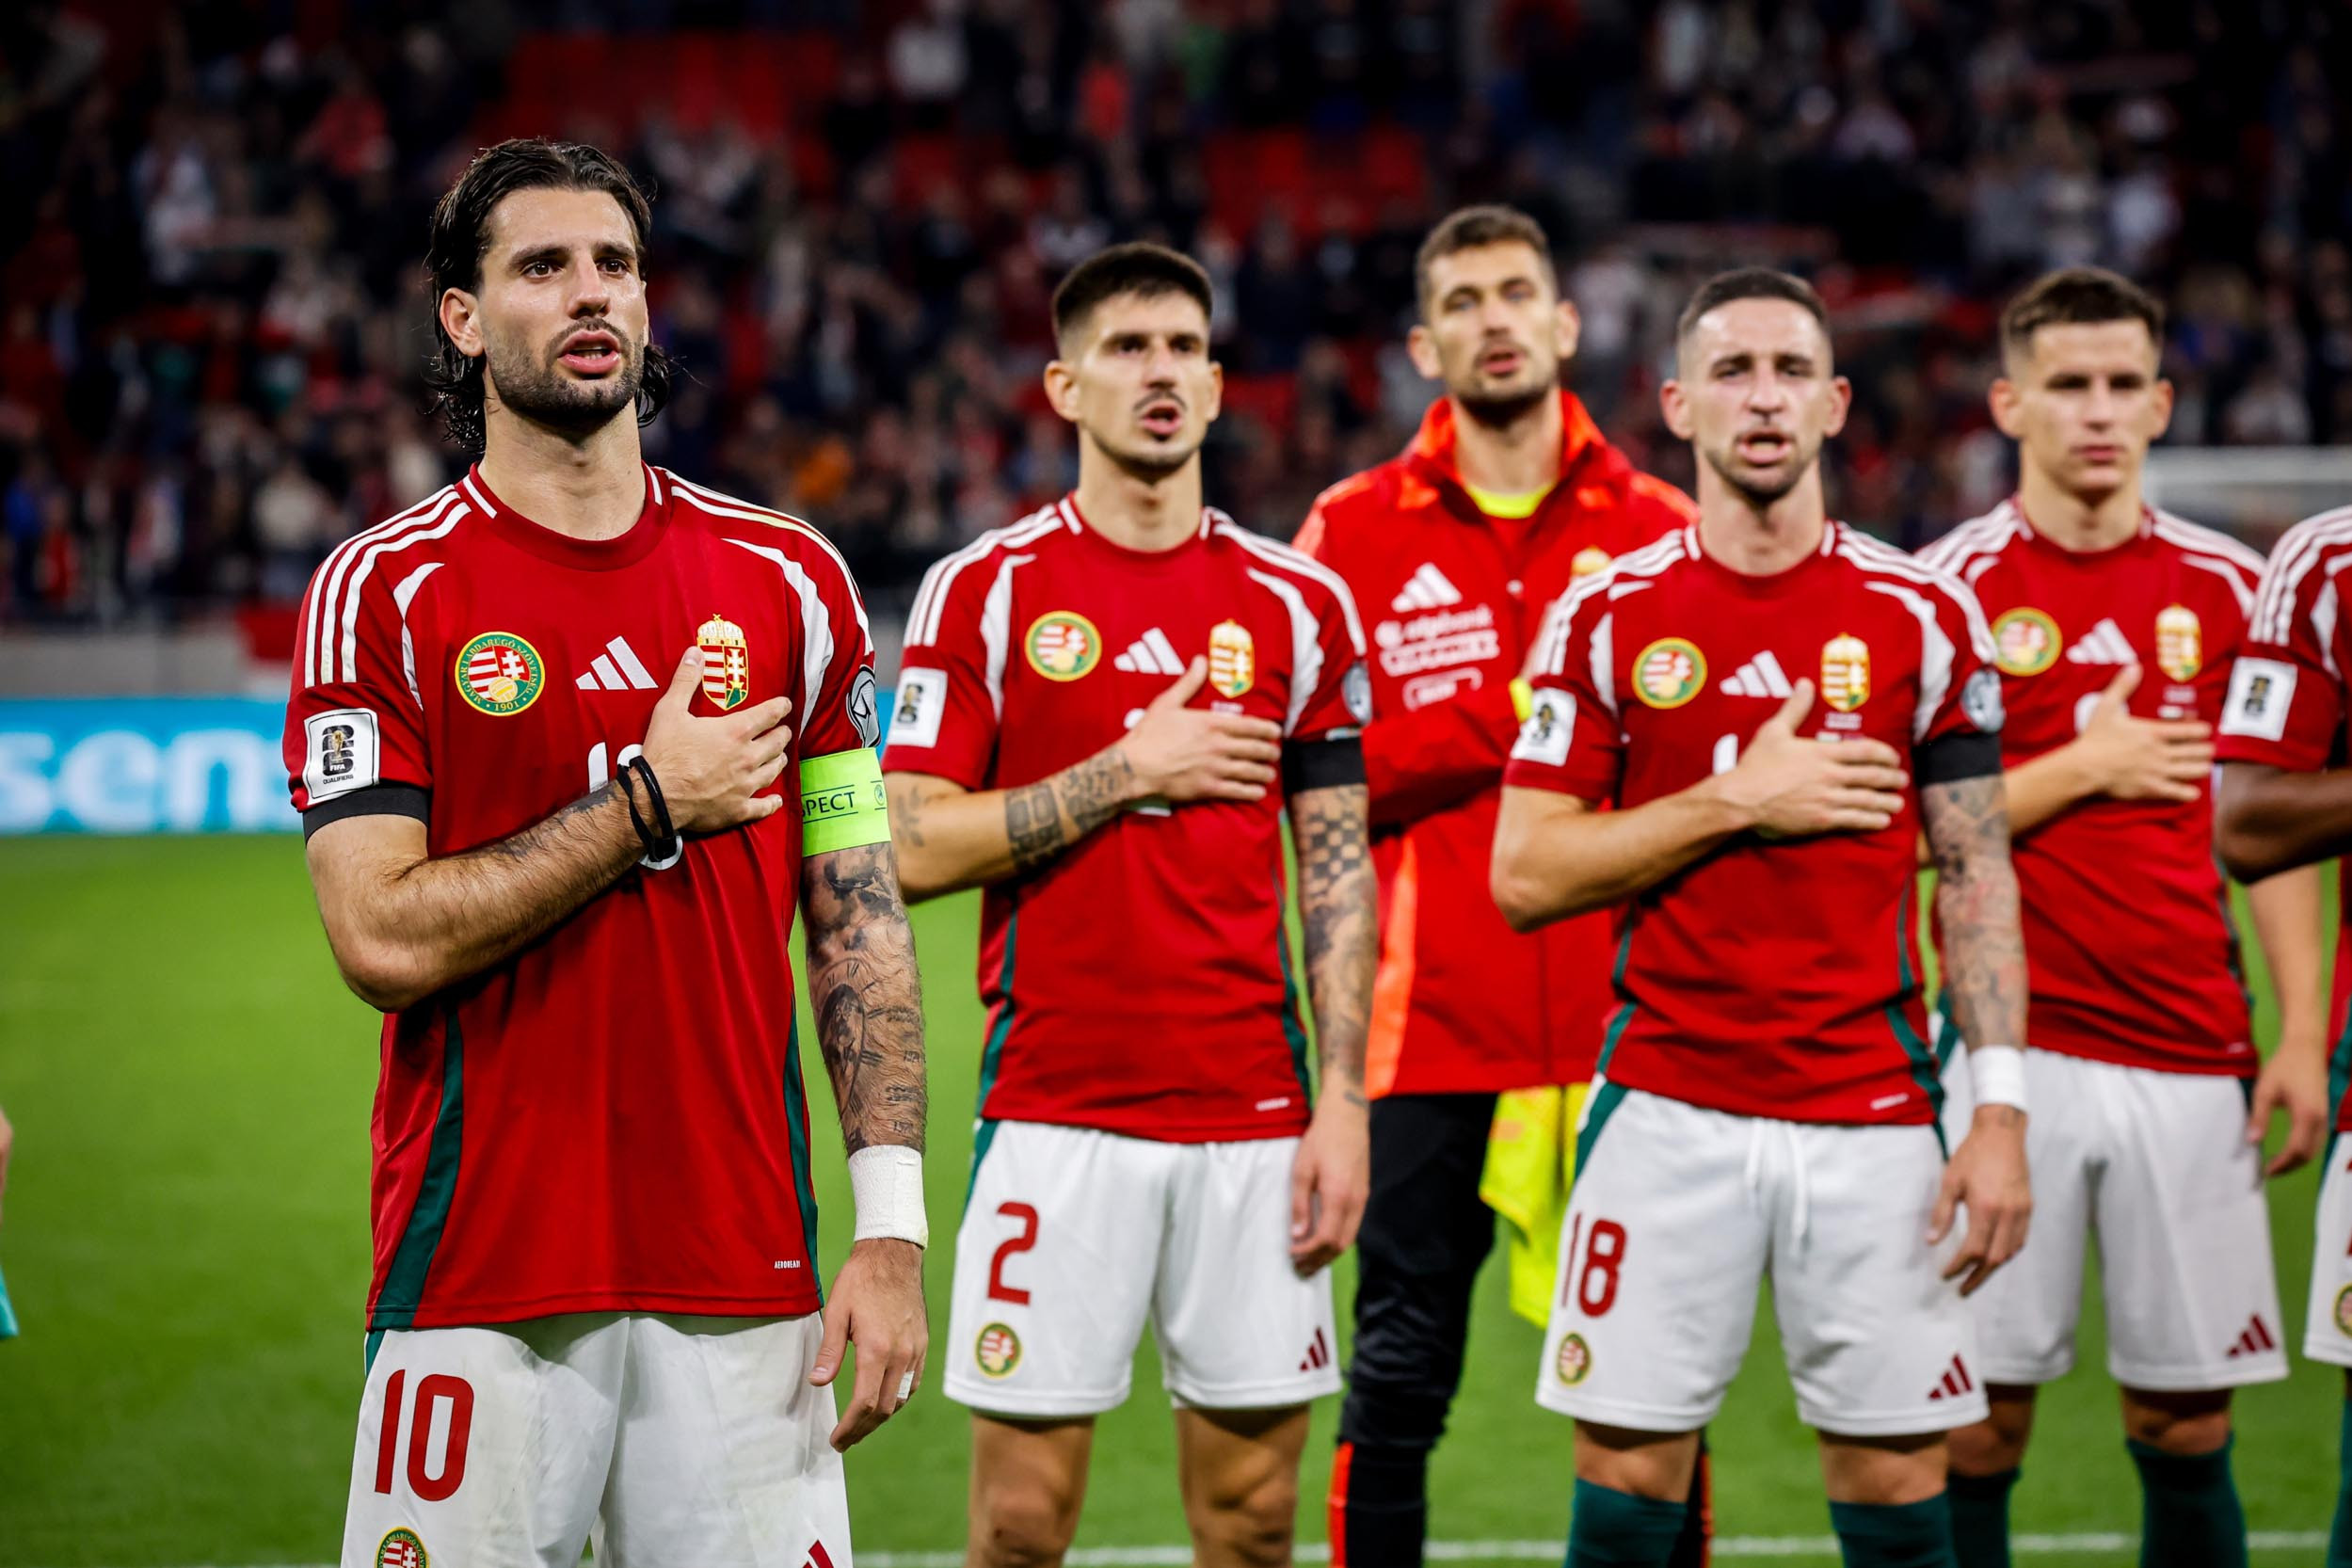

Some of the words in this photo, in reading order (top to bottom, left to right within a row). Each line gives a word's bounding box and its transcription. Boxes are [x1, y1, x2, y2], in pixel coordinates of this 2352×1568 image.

[459, 665, 484, 704] MAGYAR
[494, 702, 520, 712] 1901
[323, 774, 354, 785] QUALIFIERS
[329, 763, 346, 772] FIFA
[986, 1200, 1039, 1306] 2
[1561, 1211, 1626, 1319] 18
[374, 1368, 474, 1501] 10
